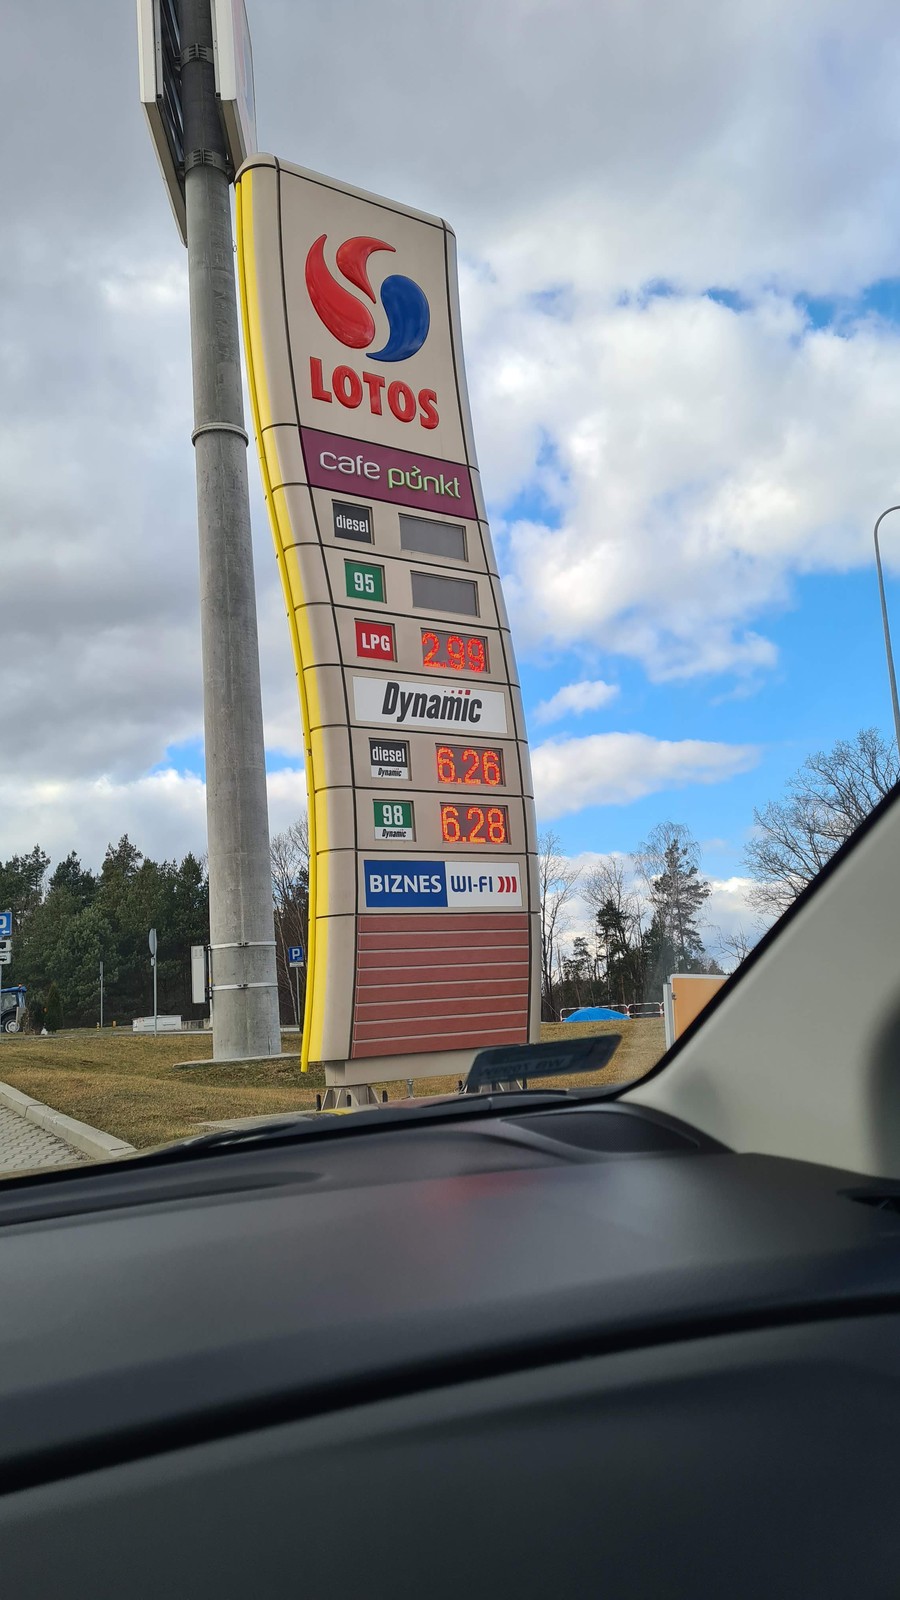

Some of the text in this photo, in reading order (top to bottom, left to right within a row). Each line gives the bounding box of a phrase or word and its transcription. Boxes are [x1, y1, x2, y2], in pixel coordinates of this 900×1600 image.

[310, 357, 440, 430] LOTOS
[319, 451, 381, 480] cafe
[336, 514, 368, 533] diesel
[353, 572, 375, 593] 95
[361, 633, 391, 651] LPG
[382, 682, 483, 723] Dynamic
[372, 746, 405, 762] diesel
[378, 767, 402, 777] Dynamic
[437, 746, 501, 785] 6.26
[382, 805, 404, 825] 98
[441, 806, 506, 843] 6.28
[382, 829, 407, 838] Dynamic
[369, 874, 493, 893] BIZNES WI-FI
[292, 948, 300, 960] P
